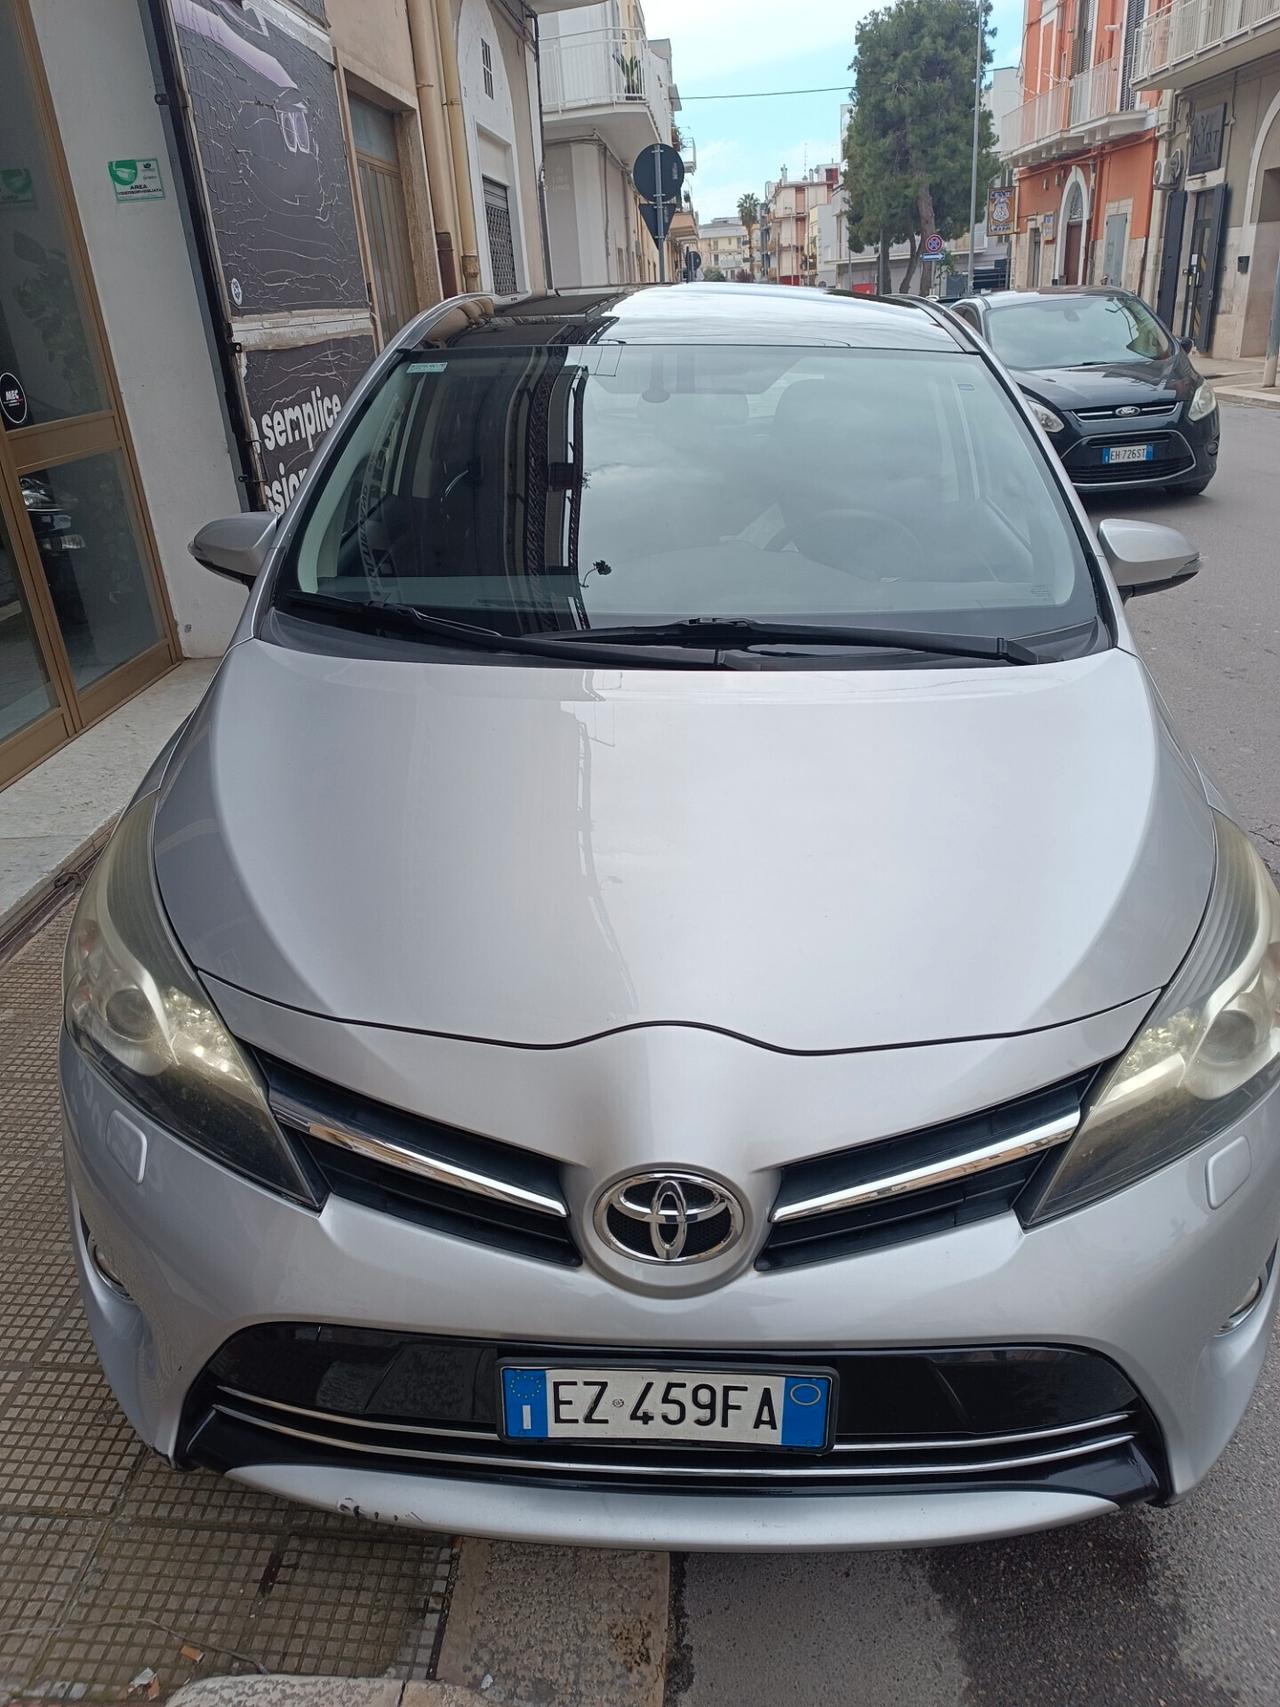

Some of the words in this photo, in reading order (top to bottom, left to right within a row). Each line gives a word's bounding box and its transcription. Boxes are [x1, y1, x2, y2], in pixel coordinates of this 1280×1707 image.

[262, 386, 342, 452] semplice
[552, 1380, 609, 1425] EZ
[629, 1381, 778, 1431] 459FA
